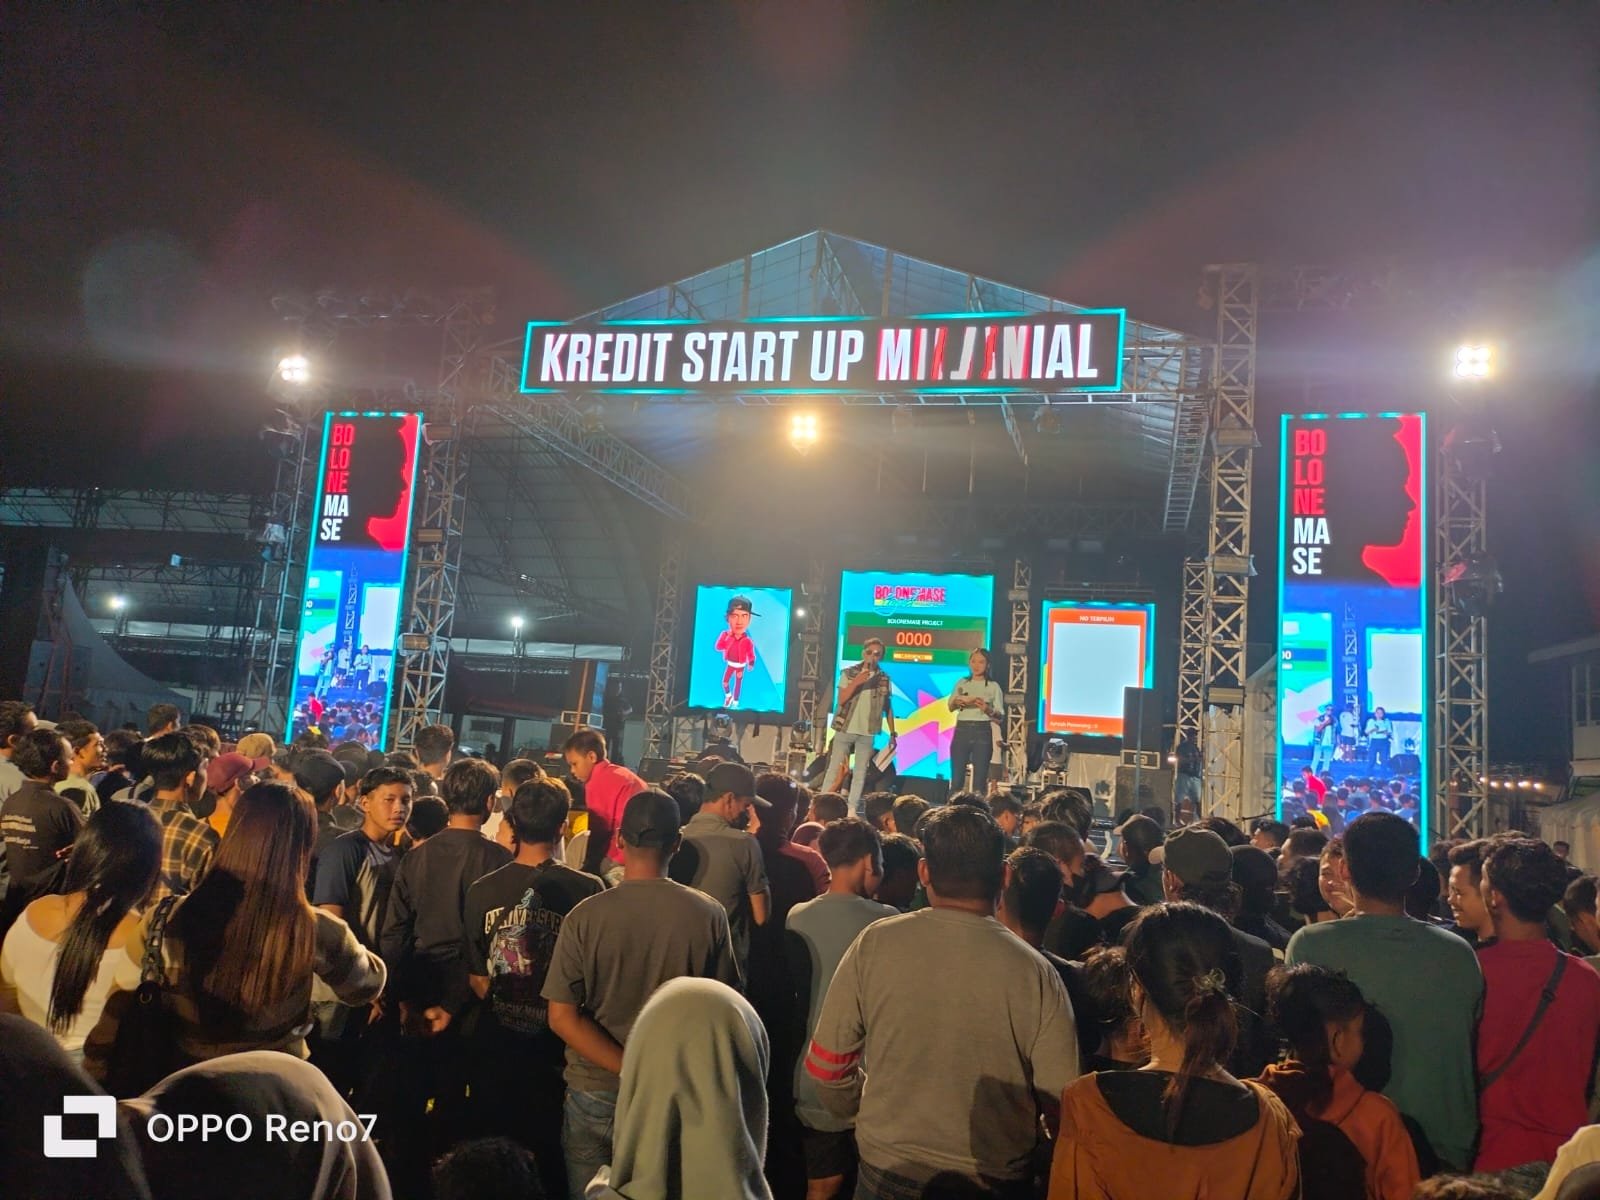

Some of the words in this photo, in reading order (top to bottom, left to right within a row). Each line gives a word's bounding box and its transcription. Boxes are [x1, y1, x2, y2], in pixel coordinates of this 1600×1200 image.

[540, 332, 673, 383] KREDIT
[682, 331, 799, 382] START
[810, 329, 865, 382] UP
[331, 423, 355, 446] BO
[1294, 428, 1327, 456] BO
[329, 447, 350, 470] LO
[326, 471, 349, 493] NE
[1294, 458, 1324, 486] LO
[323, 494, 349, 517] MA
[1293, 488, 1326, 515] NE
[320, 518, 343, 541] SE
[1293, 517, 1331, 545] MA
[1291, 546, 1322, 575] SE
[896, 631, 932, 647] 0000
